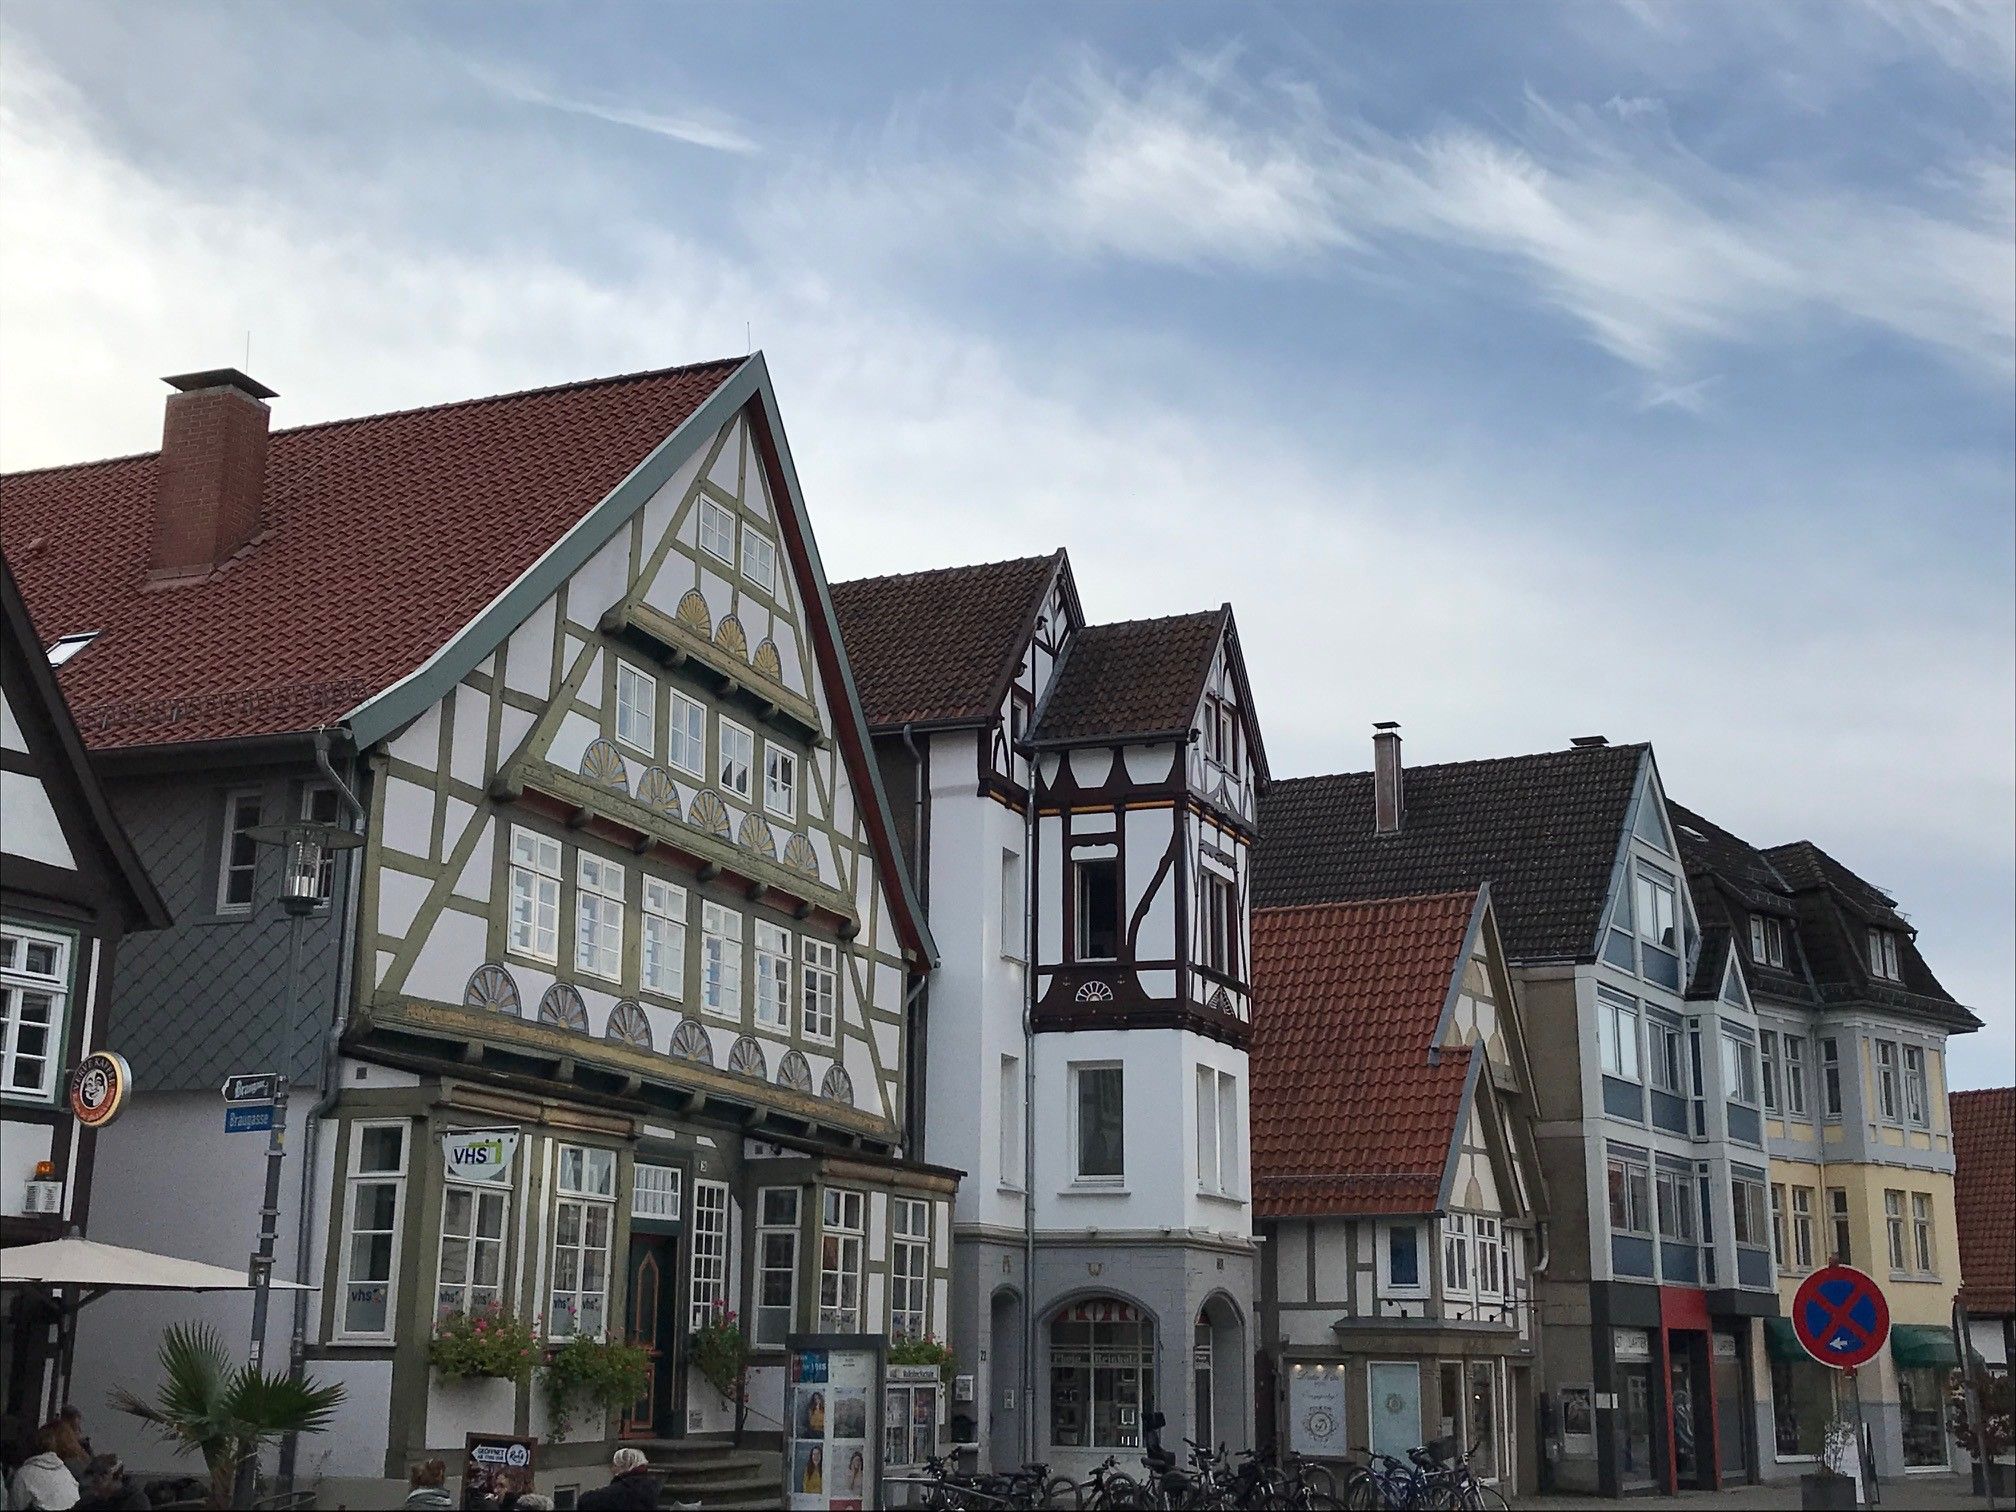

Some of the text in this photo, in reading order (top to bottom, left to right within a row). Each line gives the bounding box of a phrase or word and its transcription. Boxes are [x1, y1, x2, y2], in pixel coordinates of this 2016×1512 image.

[230, 1112, 269, 1129] Braugasse
[453, 1147, 487, 1164] VHS
[351, 1289, 373, 1301] vhs
